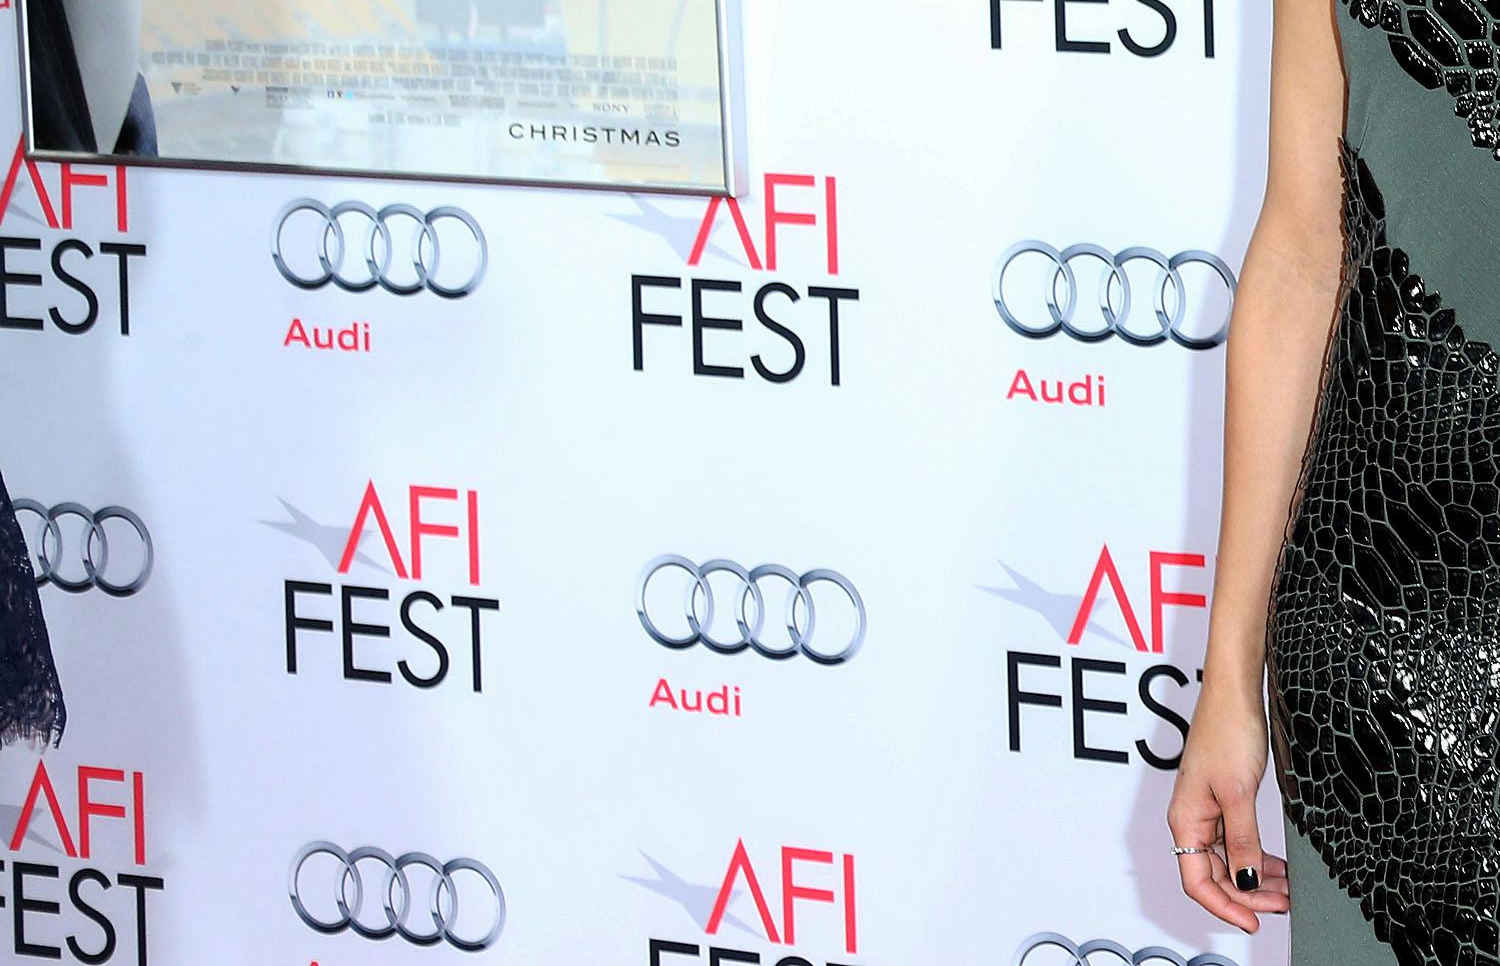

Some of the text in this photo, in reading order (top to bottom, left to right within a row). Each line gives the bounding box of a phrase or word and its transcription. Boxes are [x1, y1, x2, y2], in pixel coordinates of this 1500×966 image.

[508, 123, 681, 147] CHRISTMAS
[687, 172, 839, 276] AFI
[0, 237, 147, 336] EST
[284, 317, 371, 352] Audi
[631, 274, 860, 387] FEST
[1006, 369, 1106, 407] Audi
[337, 480, 481, 587] AFI
[284, 579, 500, 693] FEST
[1066, 544, 1208, 654] AF
[648, 677, 741, 717] Audi
[1006, 650, 1203, 771] FES
[9, 760, 146, 865] AFI
[0, 860, 165, 966] EST
[704, 837, 858, 954] AFI
